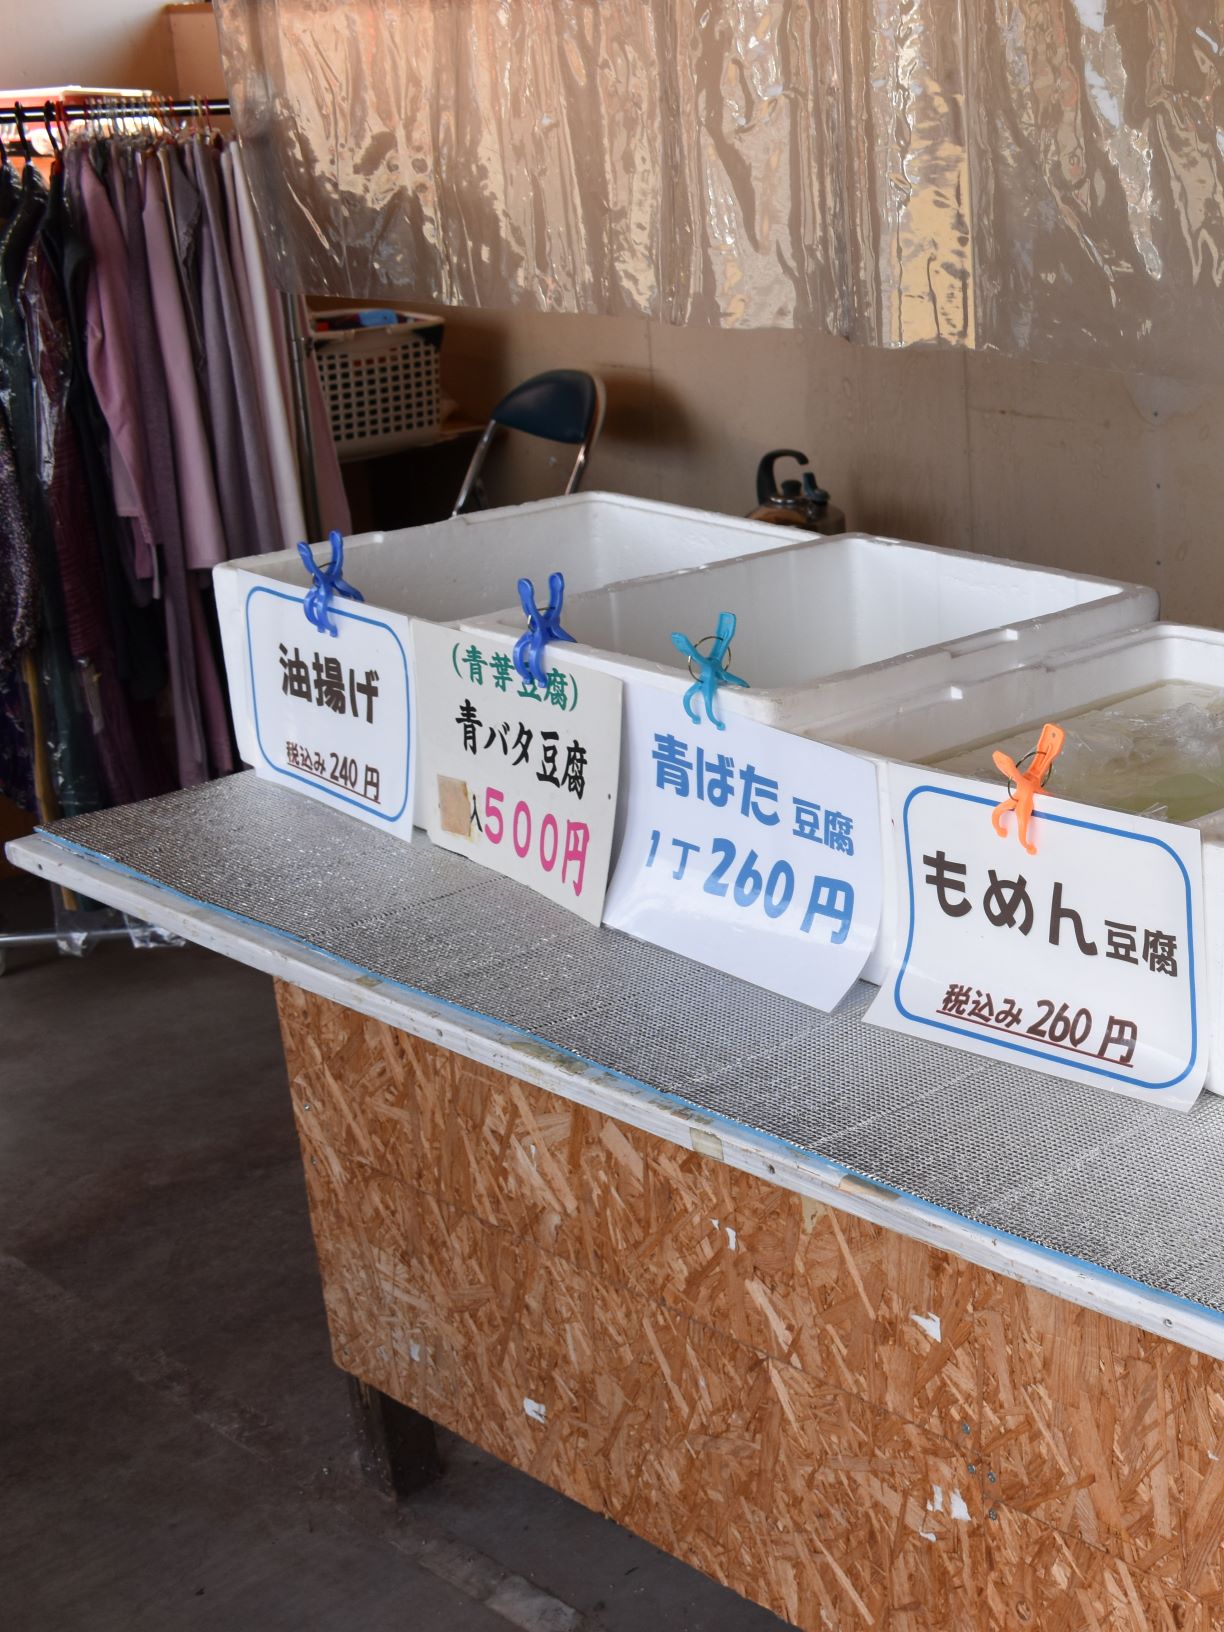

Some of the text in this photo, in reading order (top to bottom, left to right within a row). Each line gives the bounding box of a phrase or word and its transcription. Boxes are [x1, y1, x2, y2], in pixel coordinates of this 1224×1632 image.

[279, 643, 379, 724] 油揚げ
[456, 699, 588, 800] 青バタ豆腐
